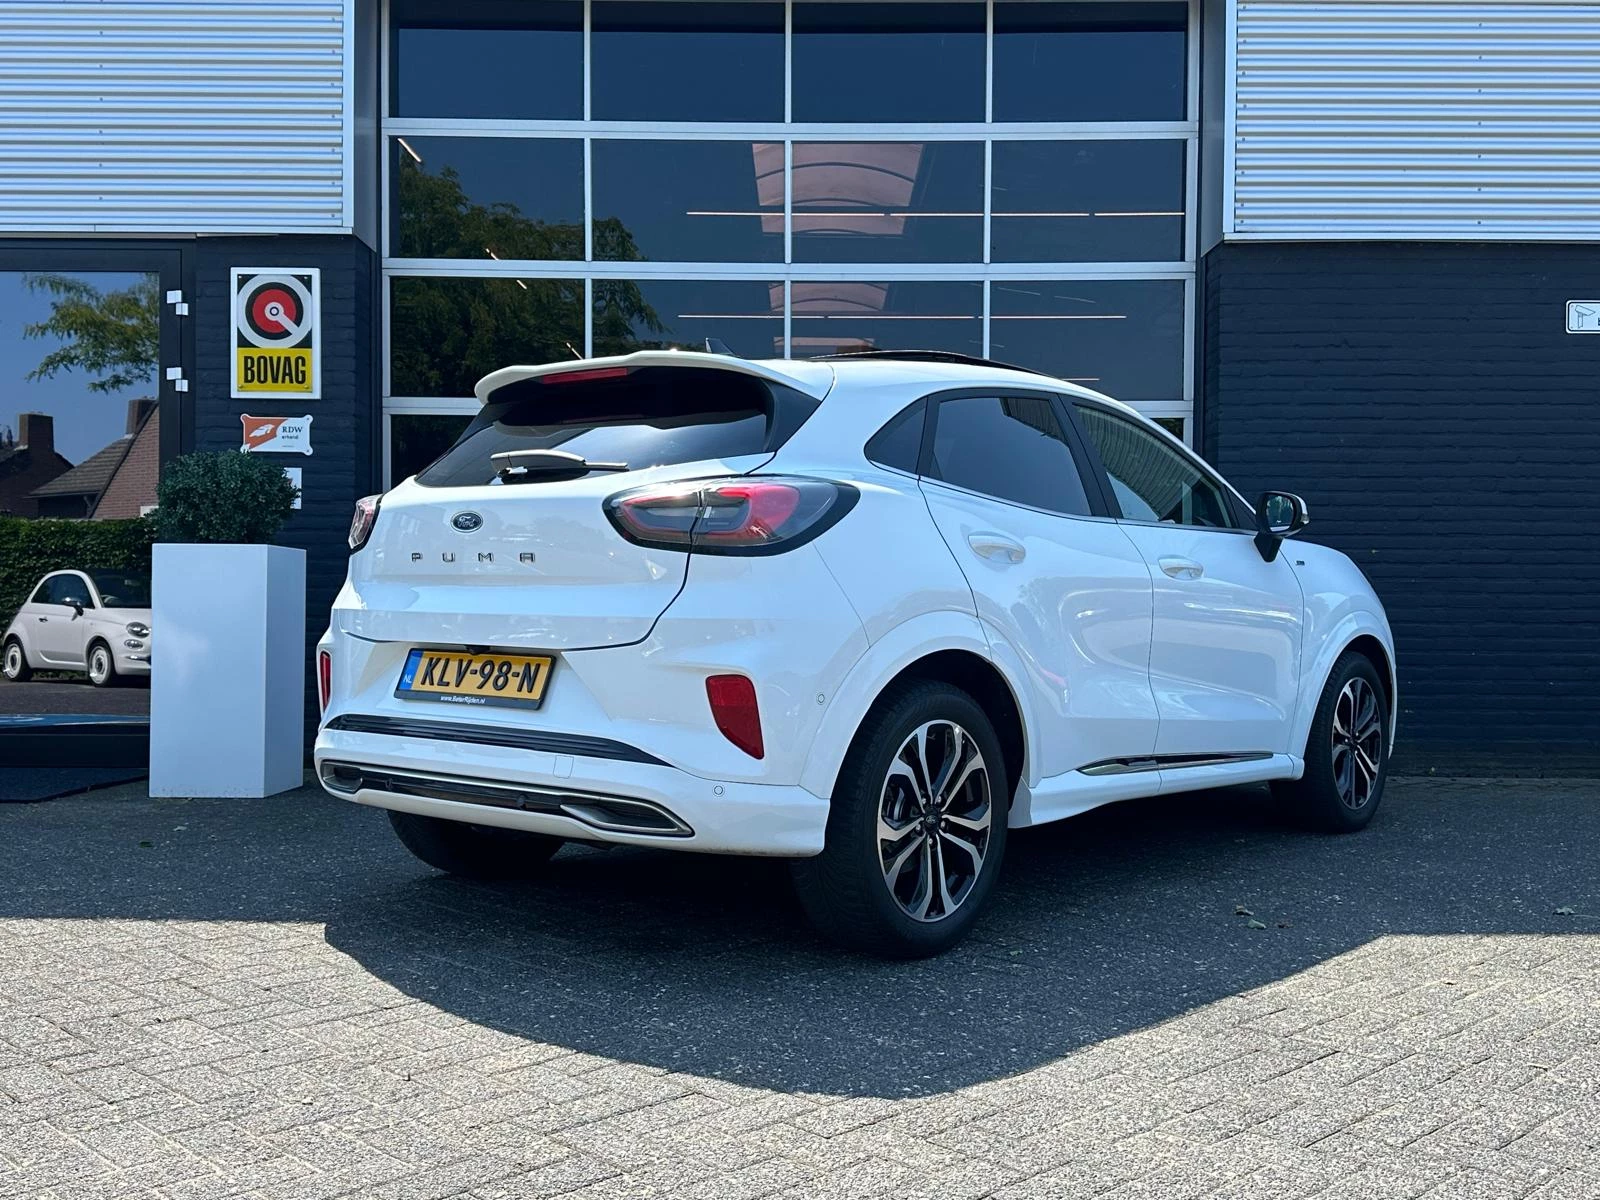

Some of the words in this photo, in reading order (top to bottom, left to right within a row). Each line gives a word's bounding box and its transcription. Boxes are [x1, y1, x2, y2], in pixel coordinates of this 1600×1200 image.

[243, 355, 306, 384] BOVAG
[411, 552, 535, 562] PUMA
[402, 674, 412, 684] NL
[420, 656, 541, 693] KLV-98-N
